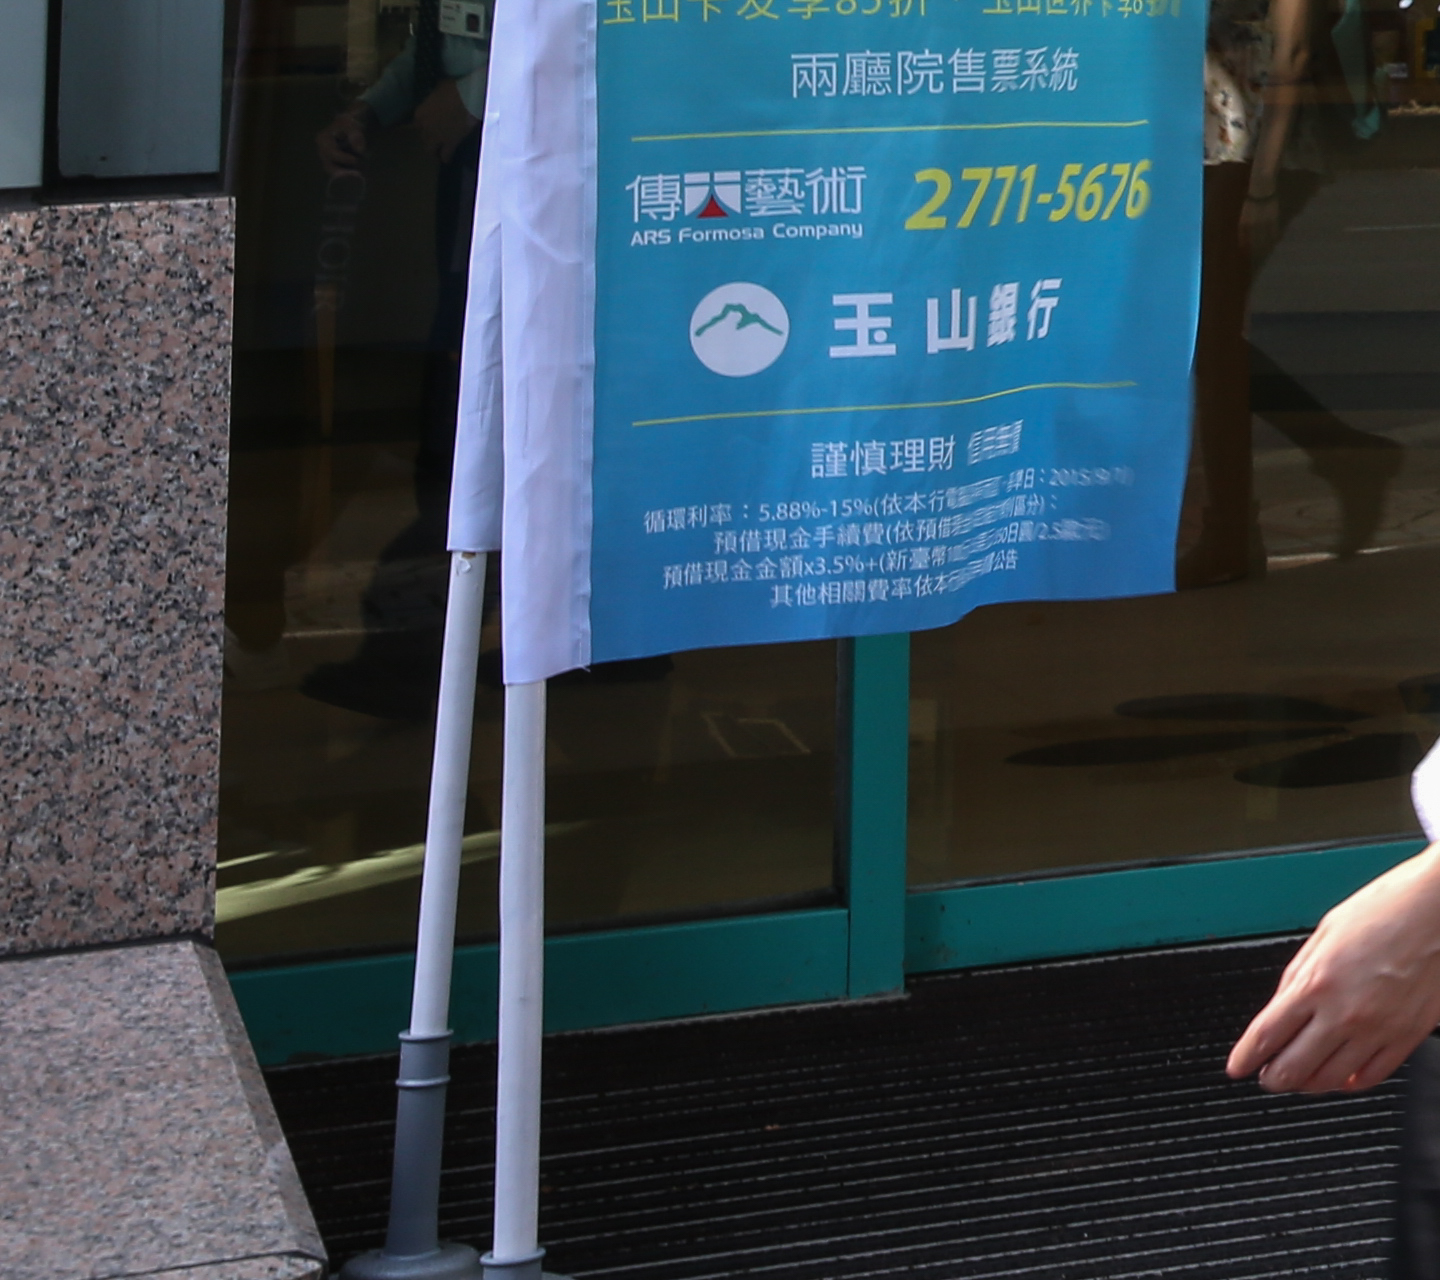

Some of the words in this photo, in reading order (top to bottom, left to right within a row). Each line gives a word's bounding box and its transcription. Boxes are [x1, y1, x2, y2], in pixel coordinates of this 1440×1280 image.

[790, 45, 1080, 99] 兩廳院售票系統
[903, 158, 1153, 231] 2771-5676
[630, 228, 672, 246] ARS
[678, 225, 765, 244] Formosa
[773, 221, 863, 240] Company
[829, 277, 1063, 358] 玉山銀行
[811, 435, 955, 479] 謹慎理財
